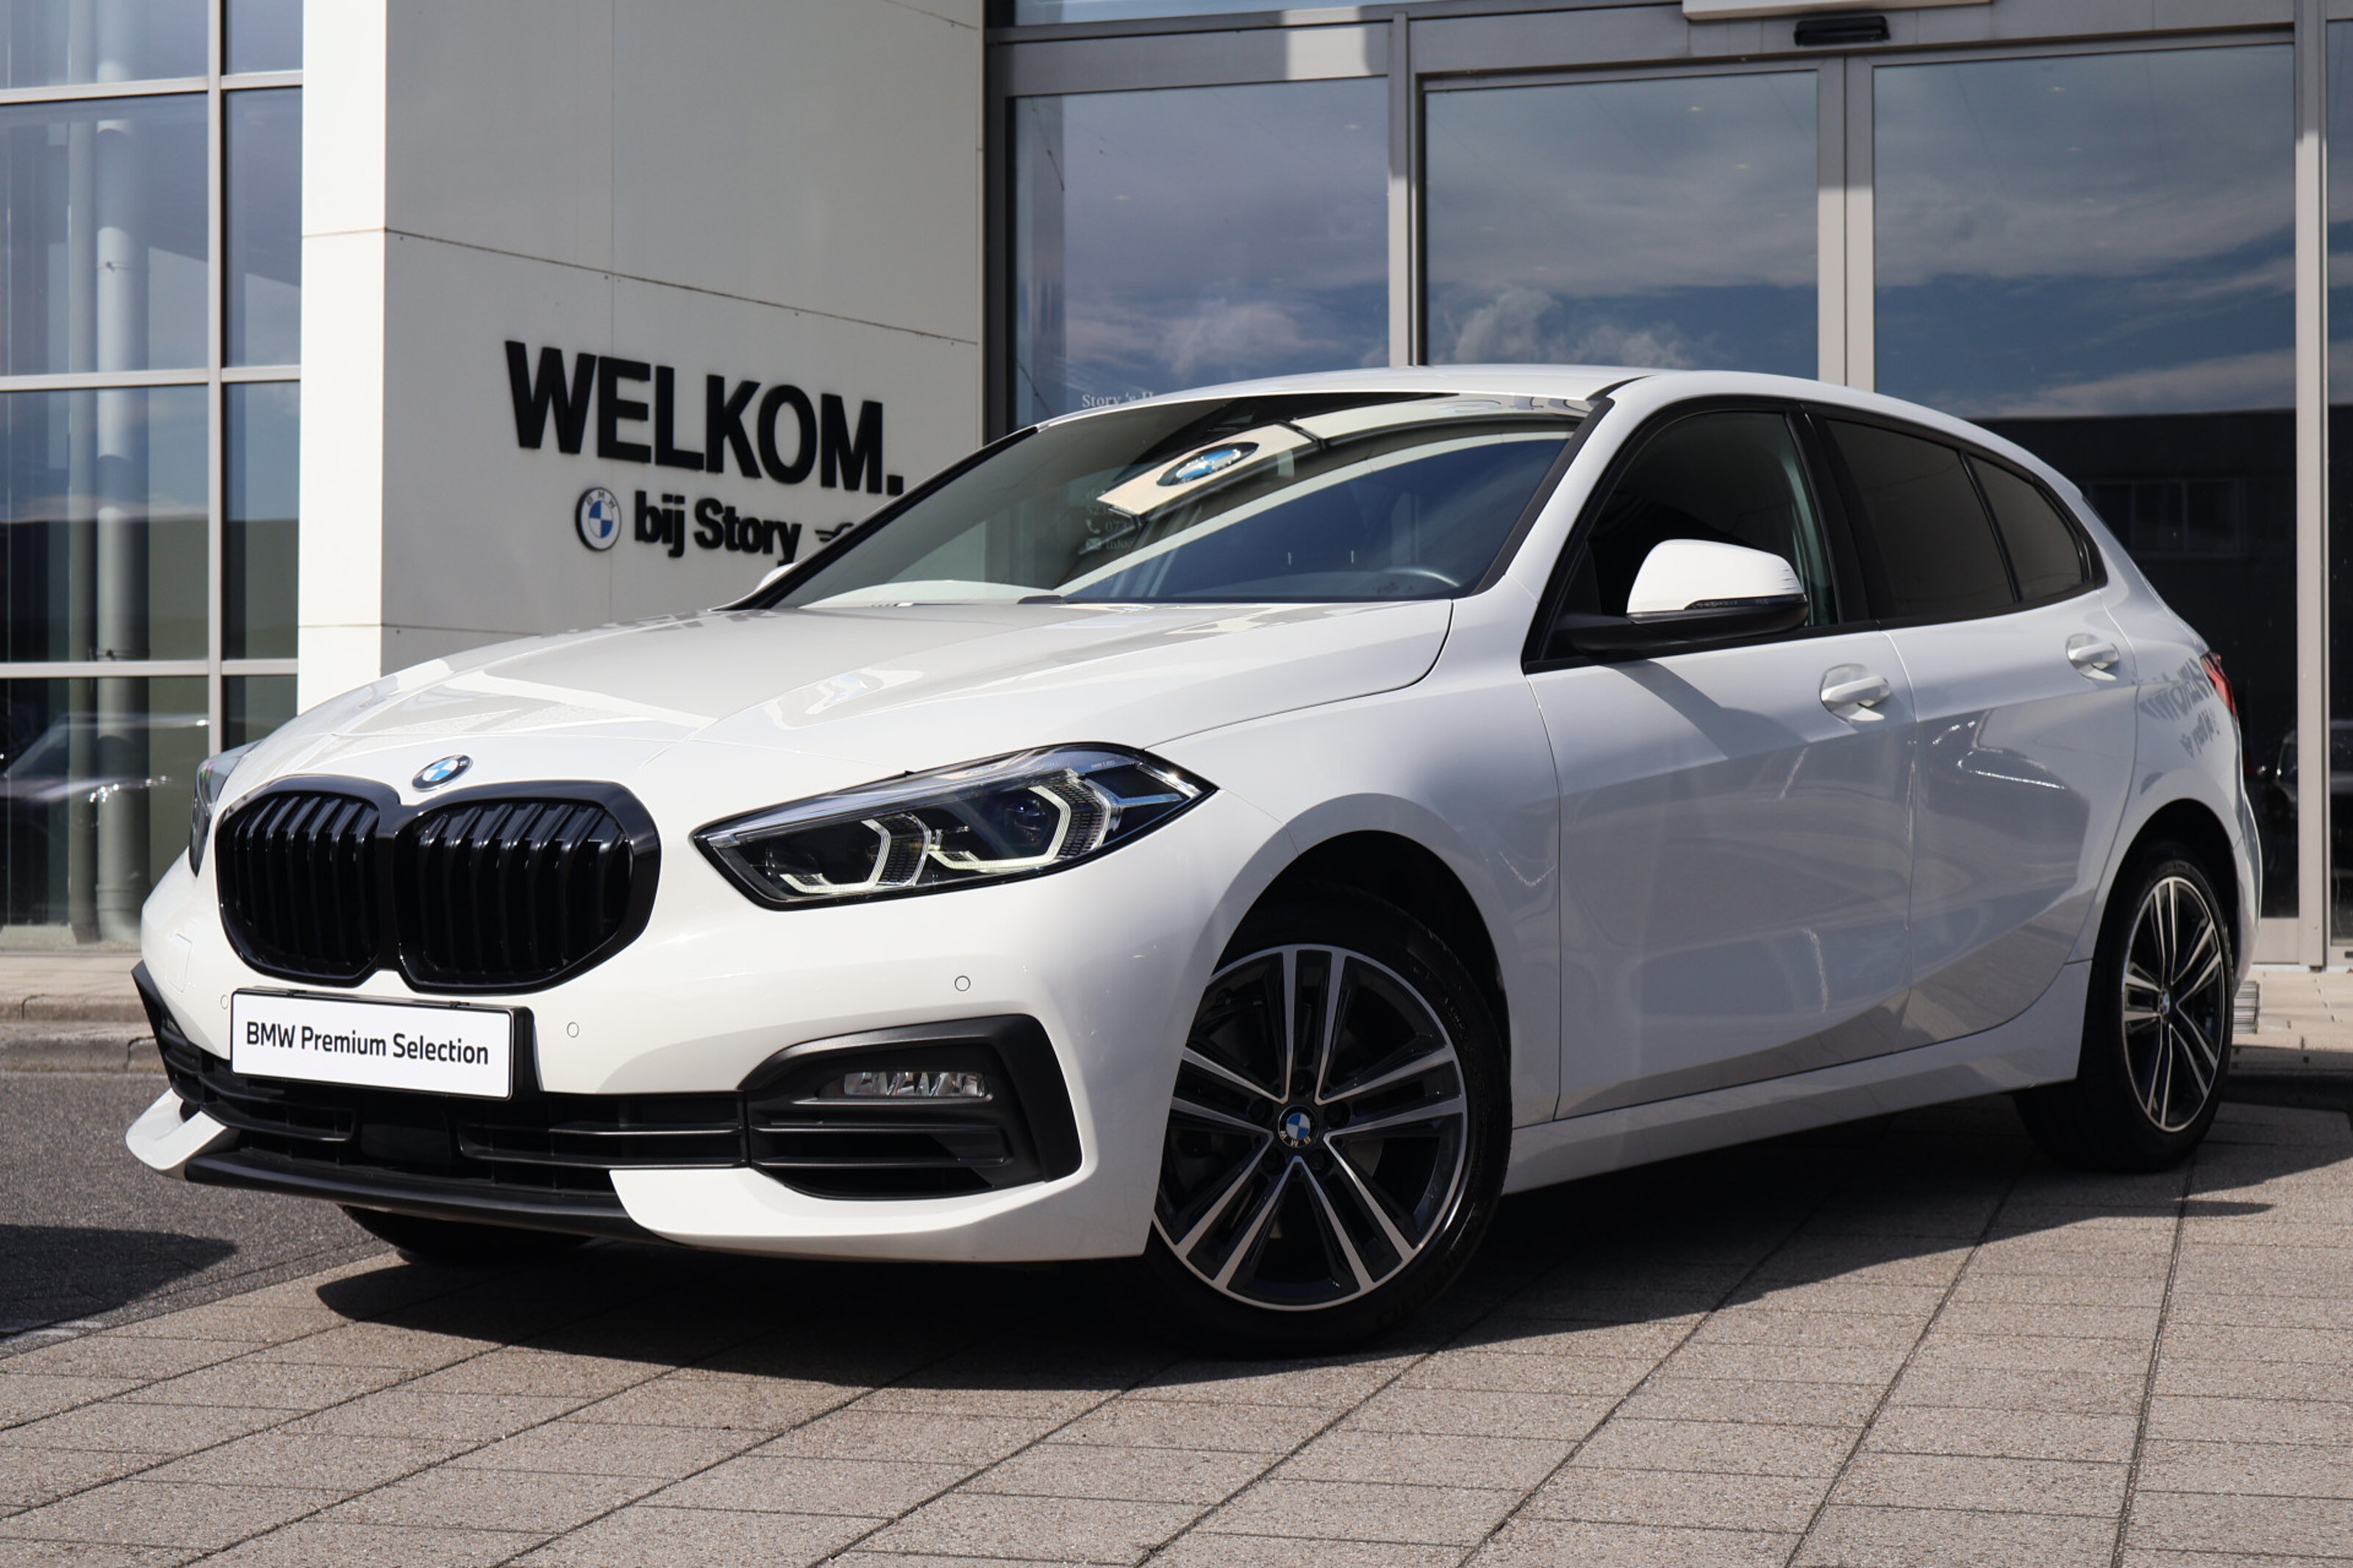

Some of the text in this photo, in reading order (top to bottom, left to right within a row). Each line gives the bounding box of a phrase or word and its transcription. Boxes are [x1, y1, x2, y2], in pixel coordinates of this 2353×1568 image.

[505, 340, 904, 496] WELKOM.
[635, 490, 802, 567] bij Story
[246, 1020, 489, 1064] BMW Premium Selection
